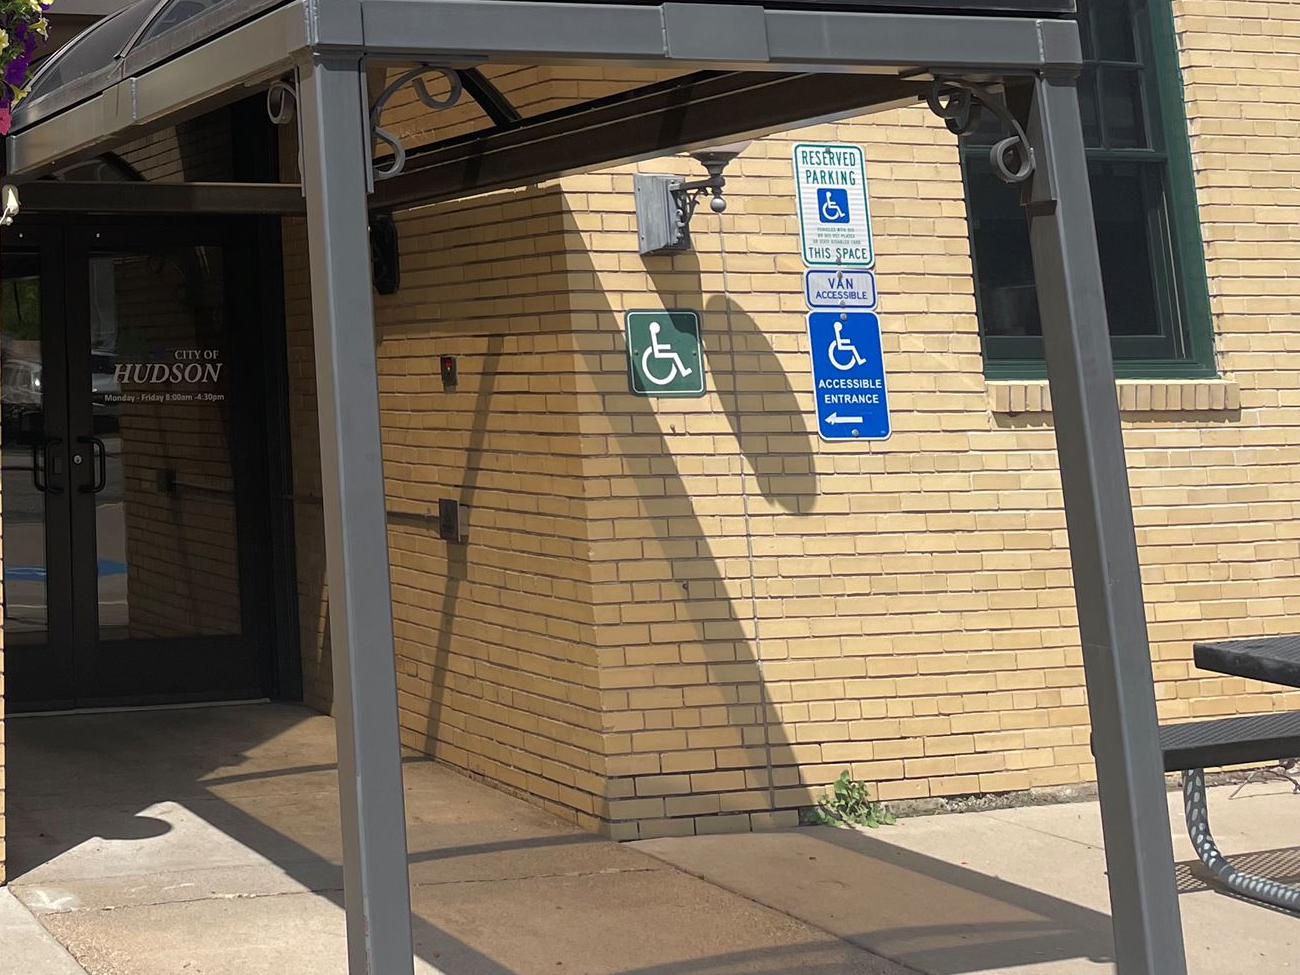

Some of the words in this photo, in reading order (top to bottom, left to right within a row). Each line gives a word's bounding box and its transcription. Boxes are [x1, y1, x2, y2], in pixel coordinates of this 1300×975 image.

[801, 150, 856, 167] RESERVED
[805, 169, 856, 186] PARKING
[808, 246, 831, 259] THIS
[835, 247, 868, 260] SPACE
[827, 277, 854, 290] VAN
[815, 290, 868, 300] ACCESSIBLE
[174, 350, 202, 360] CITY
[203, 349, 219, 360] OF
[112, 362, 223, 384] HUDSON
[818, 378, 883, 389] ACCESSIBLE
[104, 393, 135, 403] Monday
[141, 393, 164, 403] Friday
[165, 393, 193, 402] 8:00am
[824, 394, 880, 404] ENTRANCE
